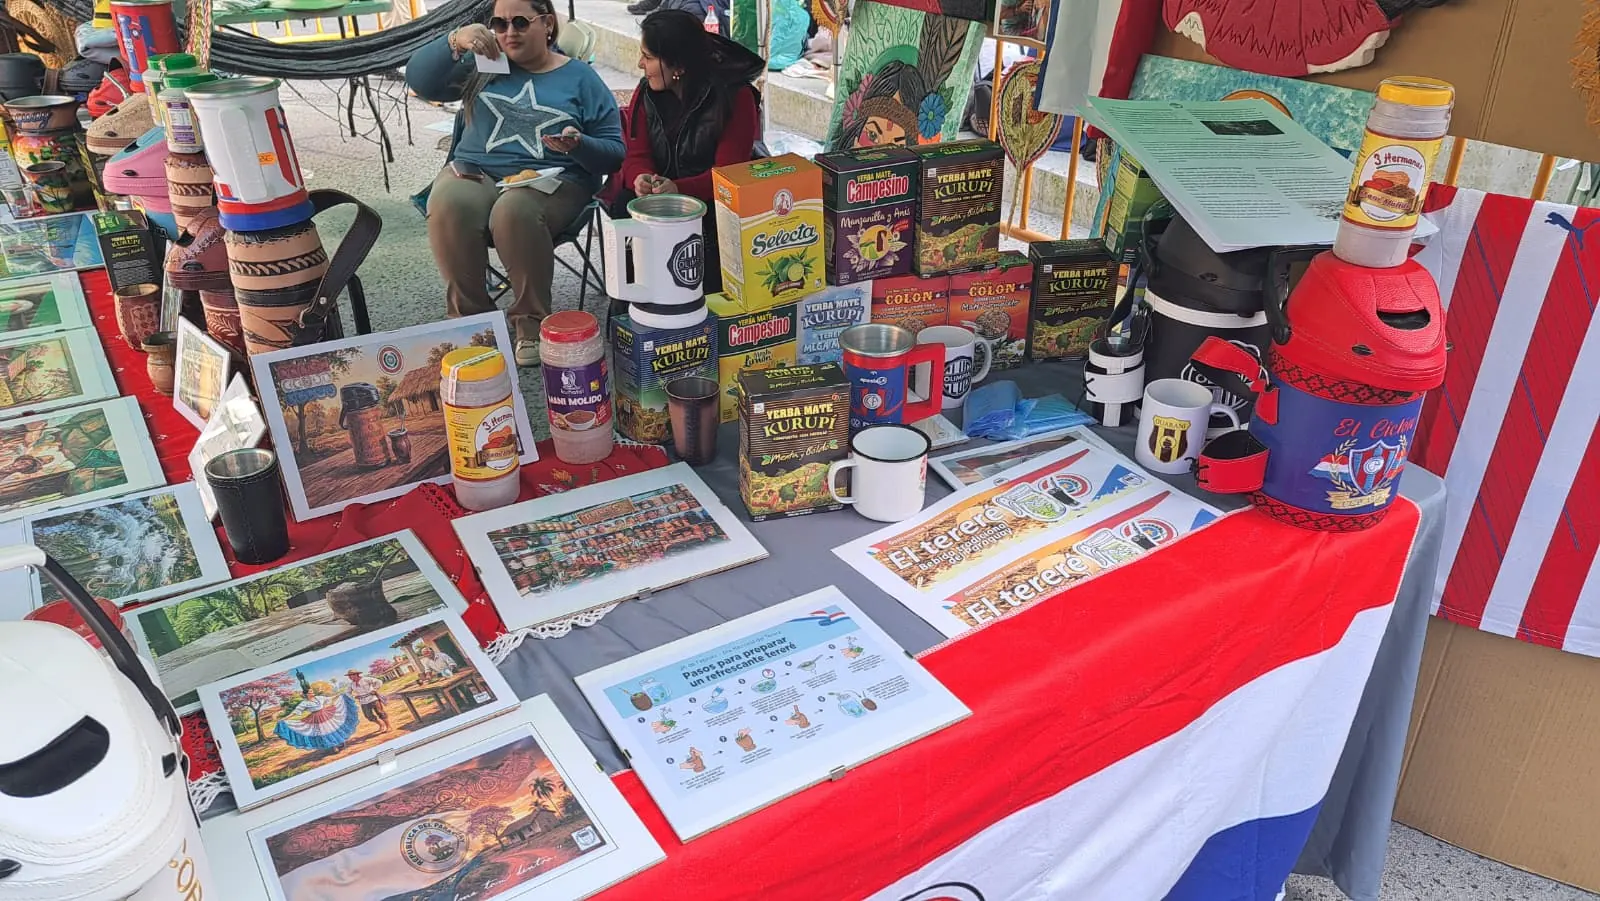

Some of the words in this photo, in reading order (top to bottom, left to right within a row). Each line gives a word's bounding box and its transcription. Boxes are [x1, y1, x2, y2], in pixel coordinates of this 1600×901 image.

[1374, 153, 1382, 165] 3
[857, 173, 874, 182] YERBA
[876, 171, 892, 180] MATE
[937, 173, 966, 184] YERBA
[968, 169, 992, 180] MATE
[847, 174, 909, 204] Campesino
[934, 179, 993, 199] KURUPÍ
[841, 211, 885, 229] Manzanilla
[752, 223, 819, 257] Selecta
[1053, 270, 1080, 279] YERBA
[1083, 268, 1107, 277] MATE
[969, 283, 1016, 297] COLON
[1050, 277, 1109, 293] KURUPÍ
[806, 301, 833, 312] YERBA
[836, 298, 860, 309] MATE
[885, 291, 933, 305] COLON
[738, 317, 755, 327] YERBA
[756, 314, 773, 323] MATE
[803, 306, 864, 327] KURUPÍ
[729, 316, 790, 346] Campesino
[655, 343, 683, 356] YERBA
[685, 335, 708, 348] MATE
[652, 344, 709, 372] KURUPÍ
[568, 394, 602, 406] MOLIDO
[767, 407, 801, 420] YERBA
[804, 404, 833, 415] MATE
[483, 421, 491, 431] 3
[763, 415, 837, 437] KURUPÍ
[1333, 418, 1361, 437] El
[771, 450, 798, 464] Menta
[888, 546, 921, 570] El
[920, 504, 1005, 554] tereré
[949, 552, 965, 566] del
[964, 527, 1013, 559] Paraguay
[919, 550, 956, 571] Bebida
[966, 597, 1001, 625] El
[1000, 552, 1089, 607] tereré
[682, 663, 716, 680] Pasos
[717, 654, 742, 669] para
[743, 636, 788, 660] preparar
[690, 678, 705, 688] un
[706, 654, 764, 682] refrescante
[765, 641, 797, 659] tereré
[417, 822, 433, 830] DEL
